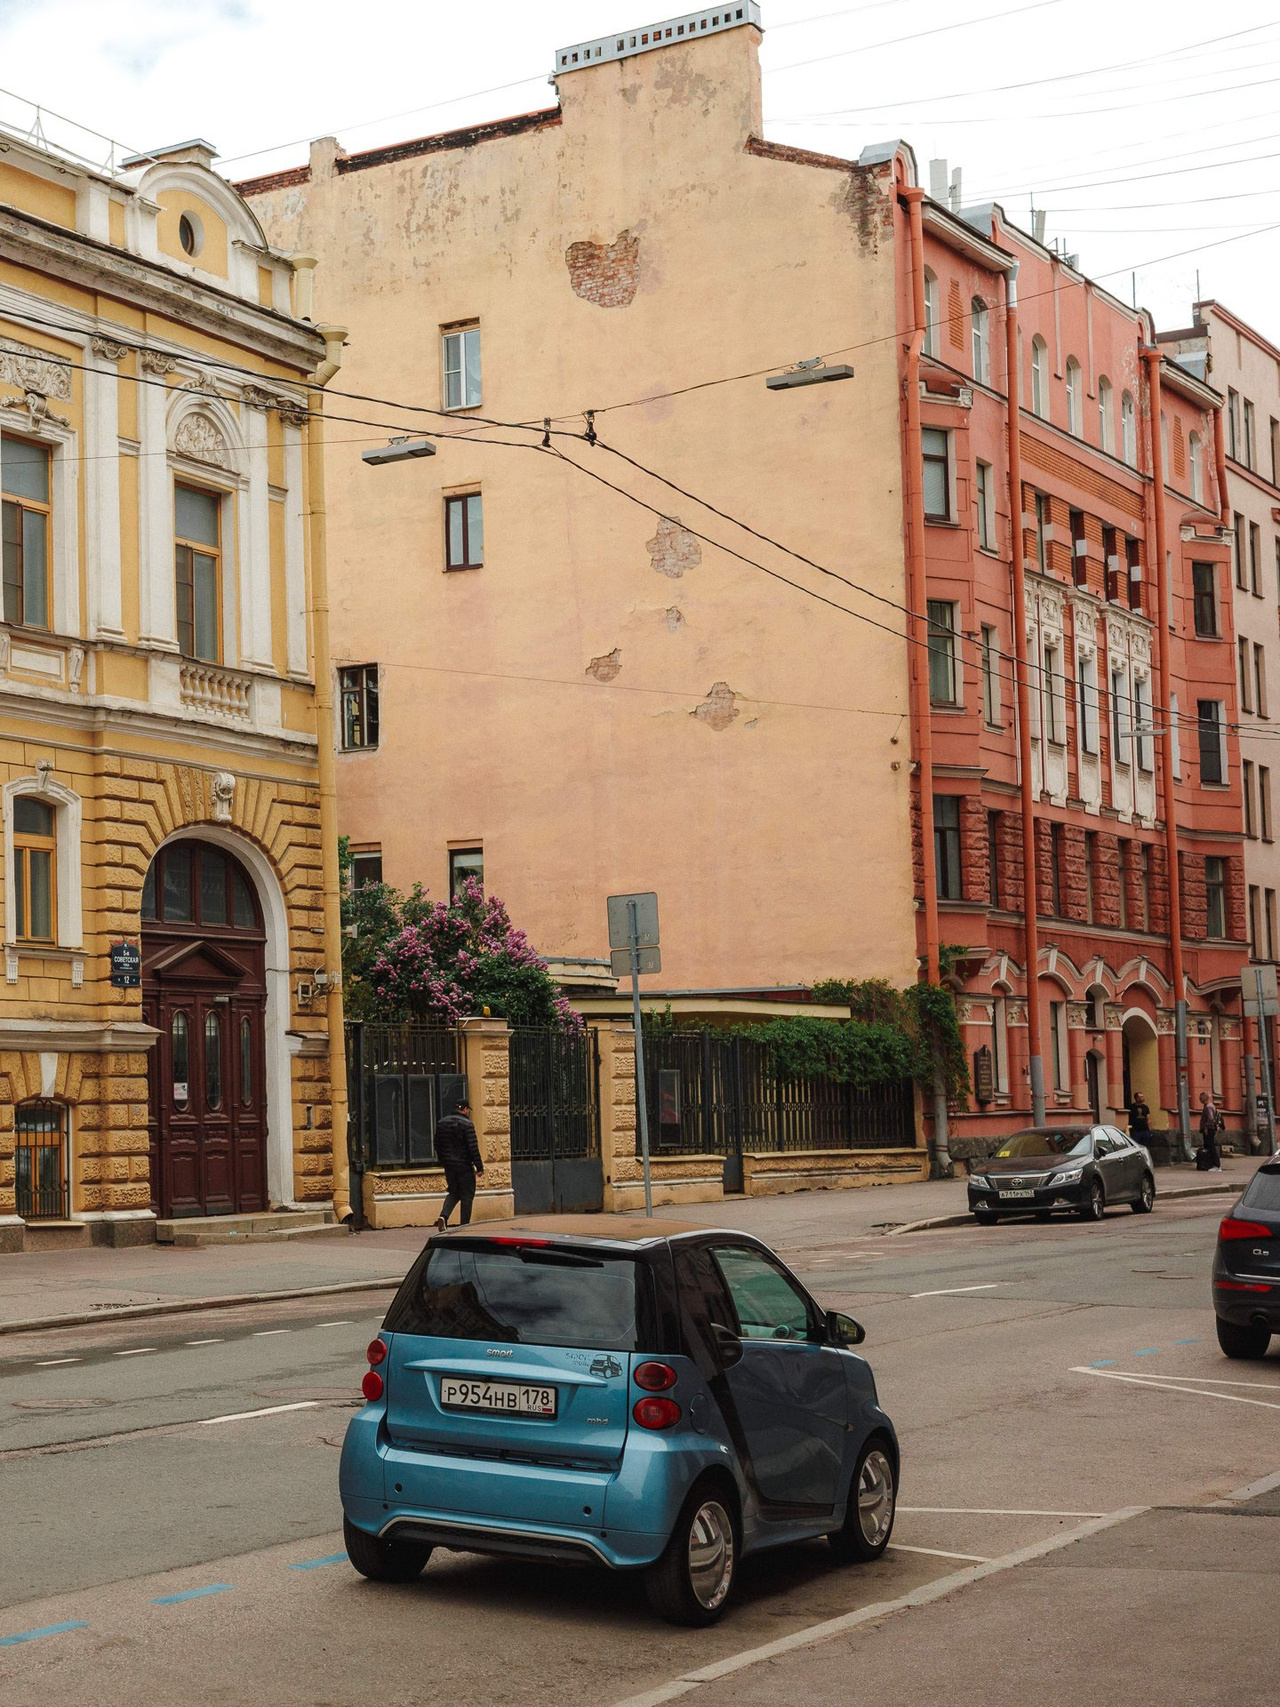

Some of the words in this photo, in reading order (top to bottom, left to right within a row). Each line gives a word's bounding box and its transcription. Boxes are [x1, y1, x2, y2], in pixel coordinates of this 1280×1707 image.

[486, 1348, 514, 1358] smart
[522, 1388, 549, 1406] 178
[528, 1404, 541, 1412] RUS
